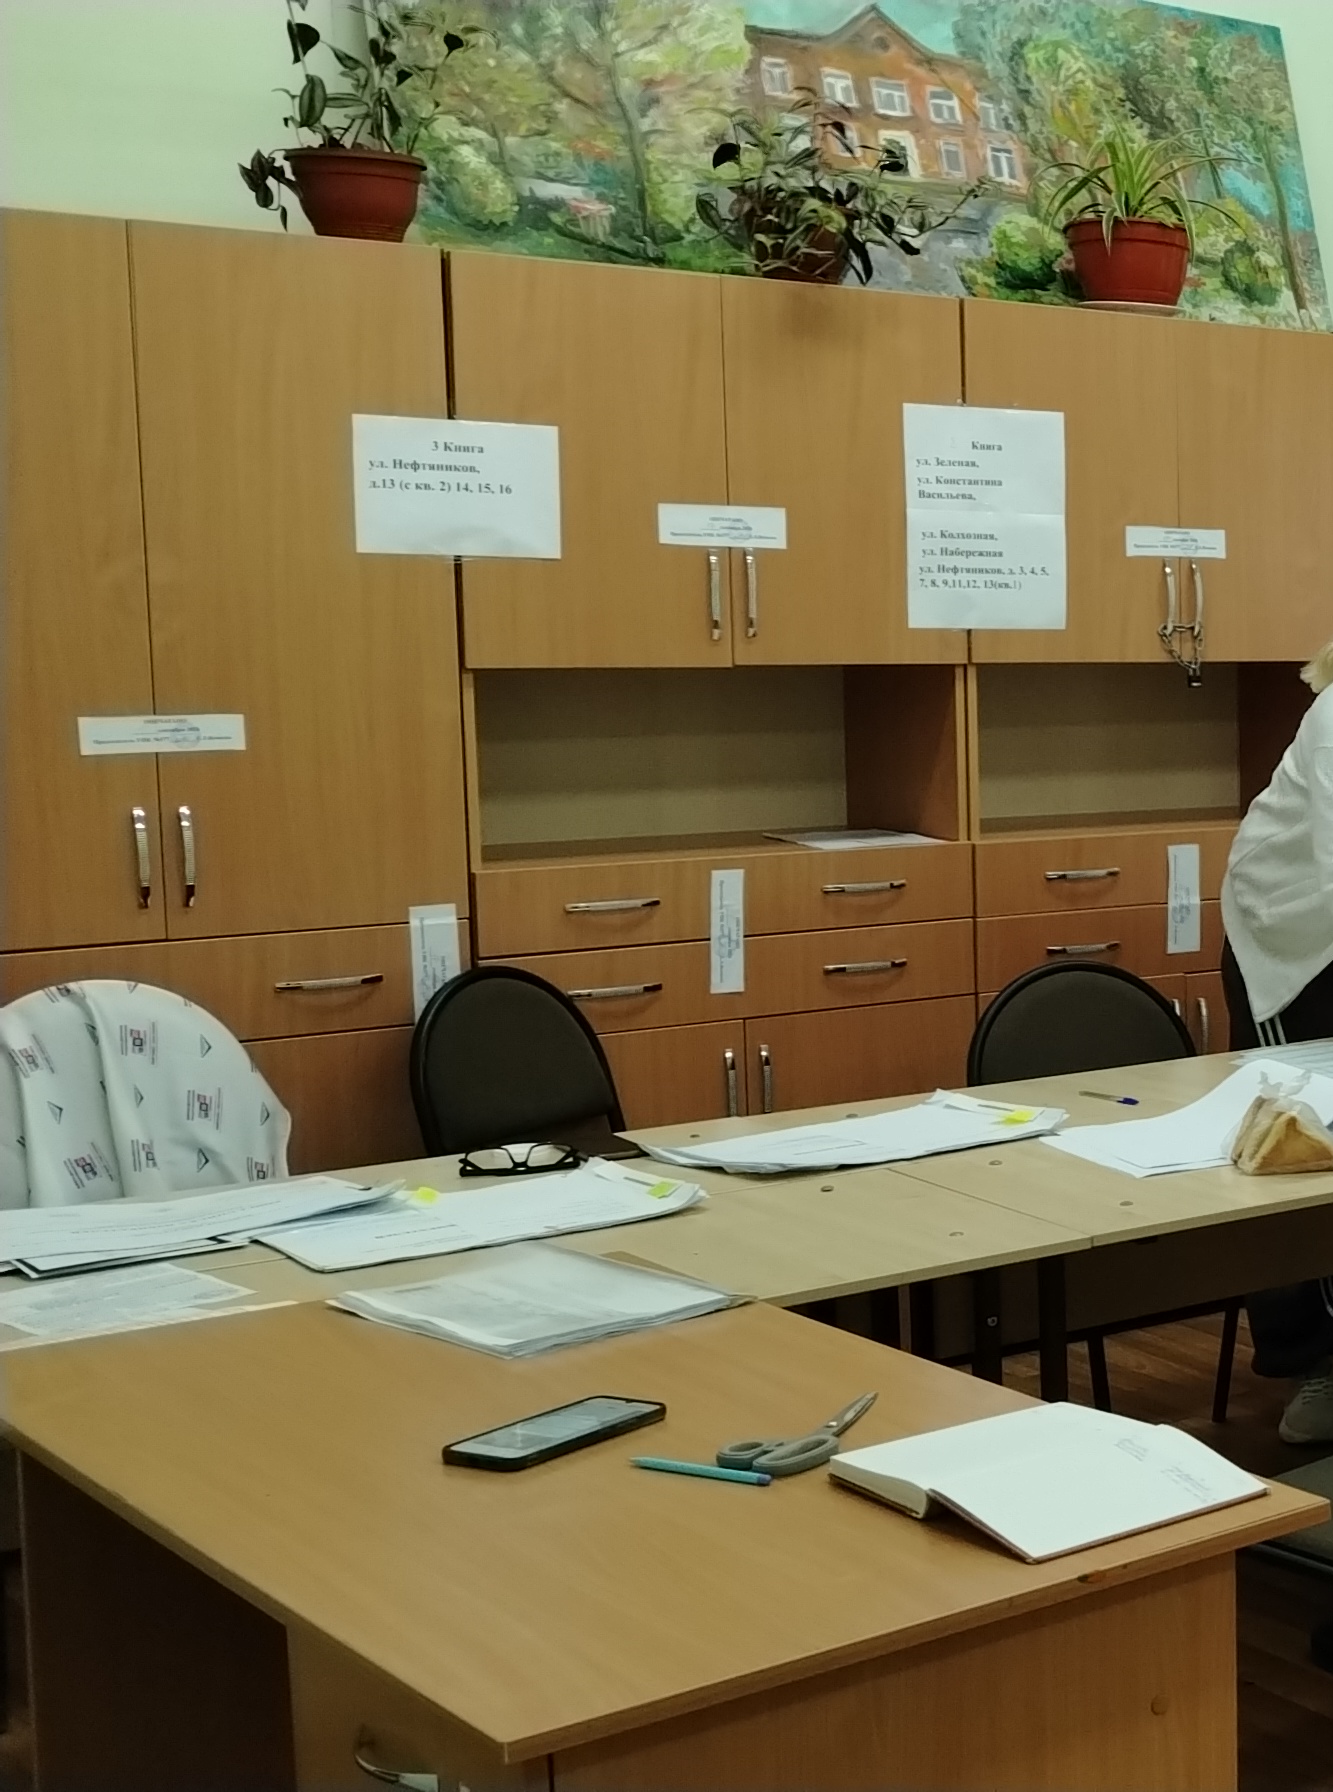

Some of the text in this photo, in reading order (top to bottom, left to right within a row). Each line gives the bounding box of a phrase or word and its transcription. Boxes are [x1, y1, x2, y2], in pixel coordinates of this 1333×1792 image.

[431, 440, 484, 454] 3 Книга
[971, 440, 1003, 452] Книга
[368, 458, 481, 473] ул. Нефтяников,
[915, 456, 980, 468] ул. Зеленая,
[368, 478, 396, 489] д.13
[399, 479, 411, 492] (с
[415, 482, 435, 492] кв.
[439, 481, 452, 493] 2)
[499, 484, 513, 495] 16
[917, 475, 1003, 487] ул. Константина
[918, 489, 977, 501] Васильева,
[921, 529, 999, 542] ул. Колхозная,
[921, 546, 1004, 559] ул. Набережная
[918, 564, 935, 575] ул.
